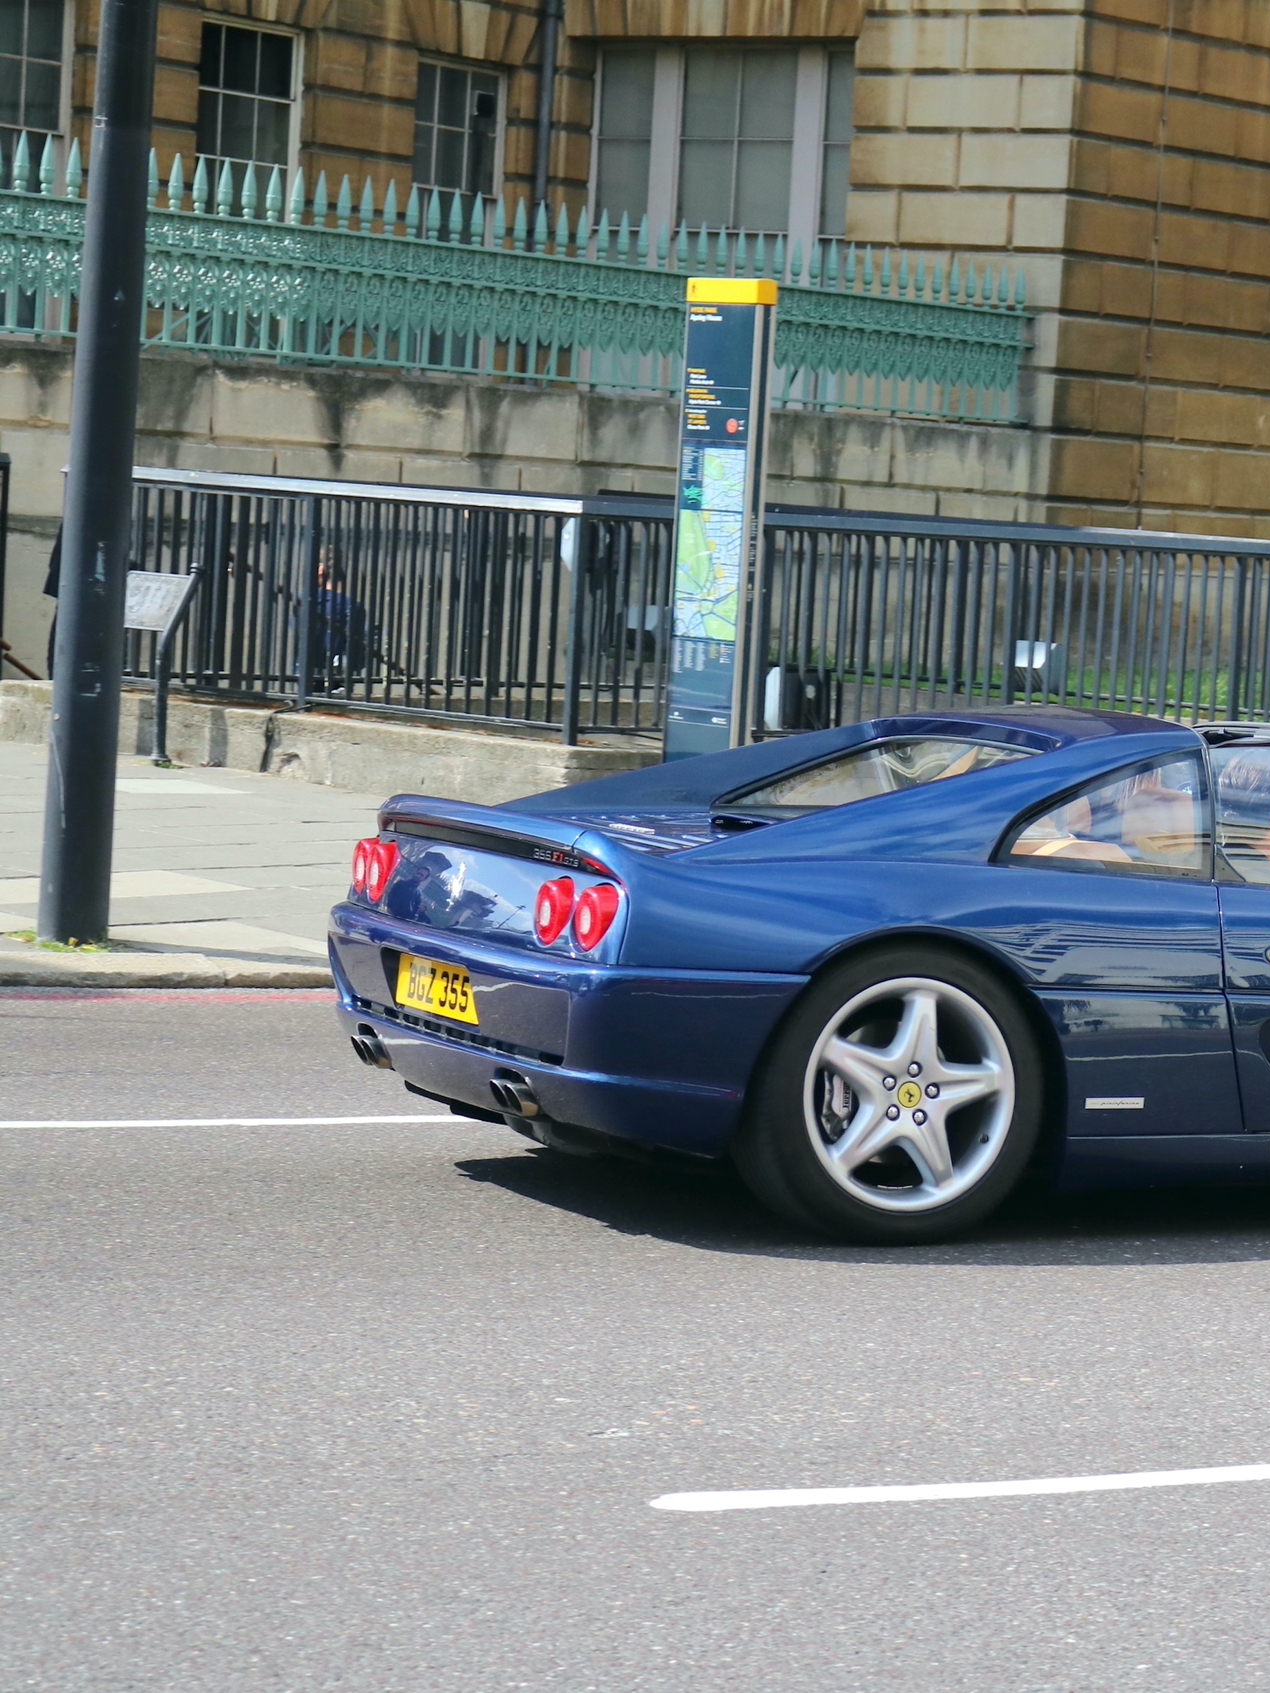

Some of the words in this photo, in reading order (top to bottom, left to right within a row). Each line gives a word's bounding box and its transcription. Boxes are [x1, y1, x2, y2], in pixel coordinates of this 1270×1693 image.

[533, 848, 551, 860] 355
[407, 962, 437, 1005] BGZ
[438, 971, 470, 1013] 355
